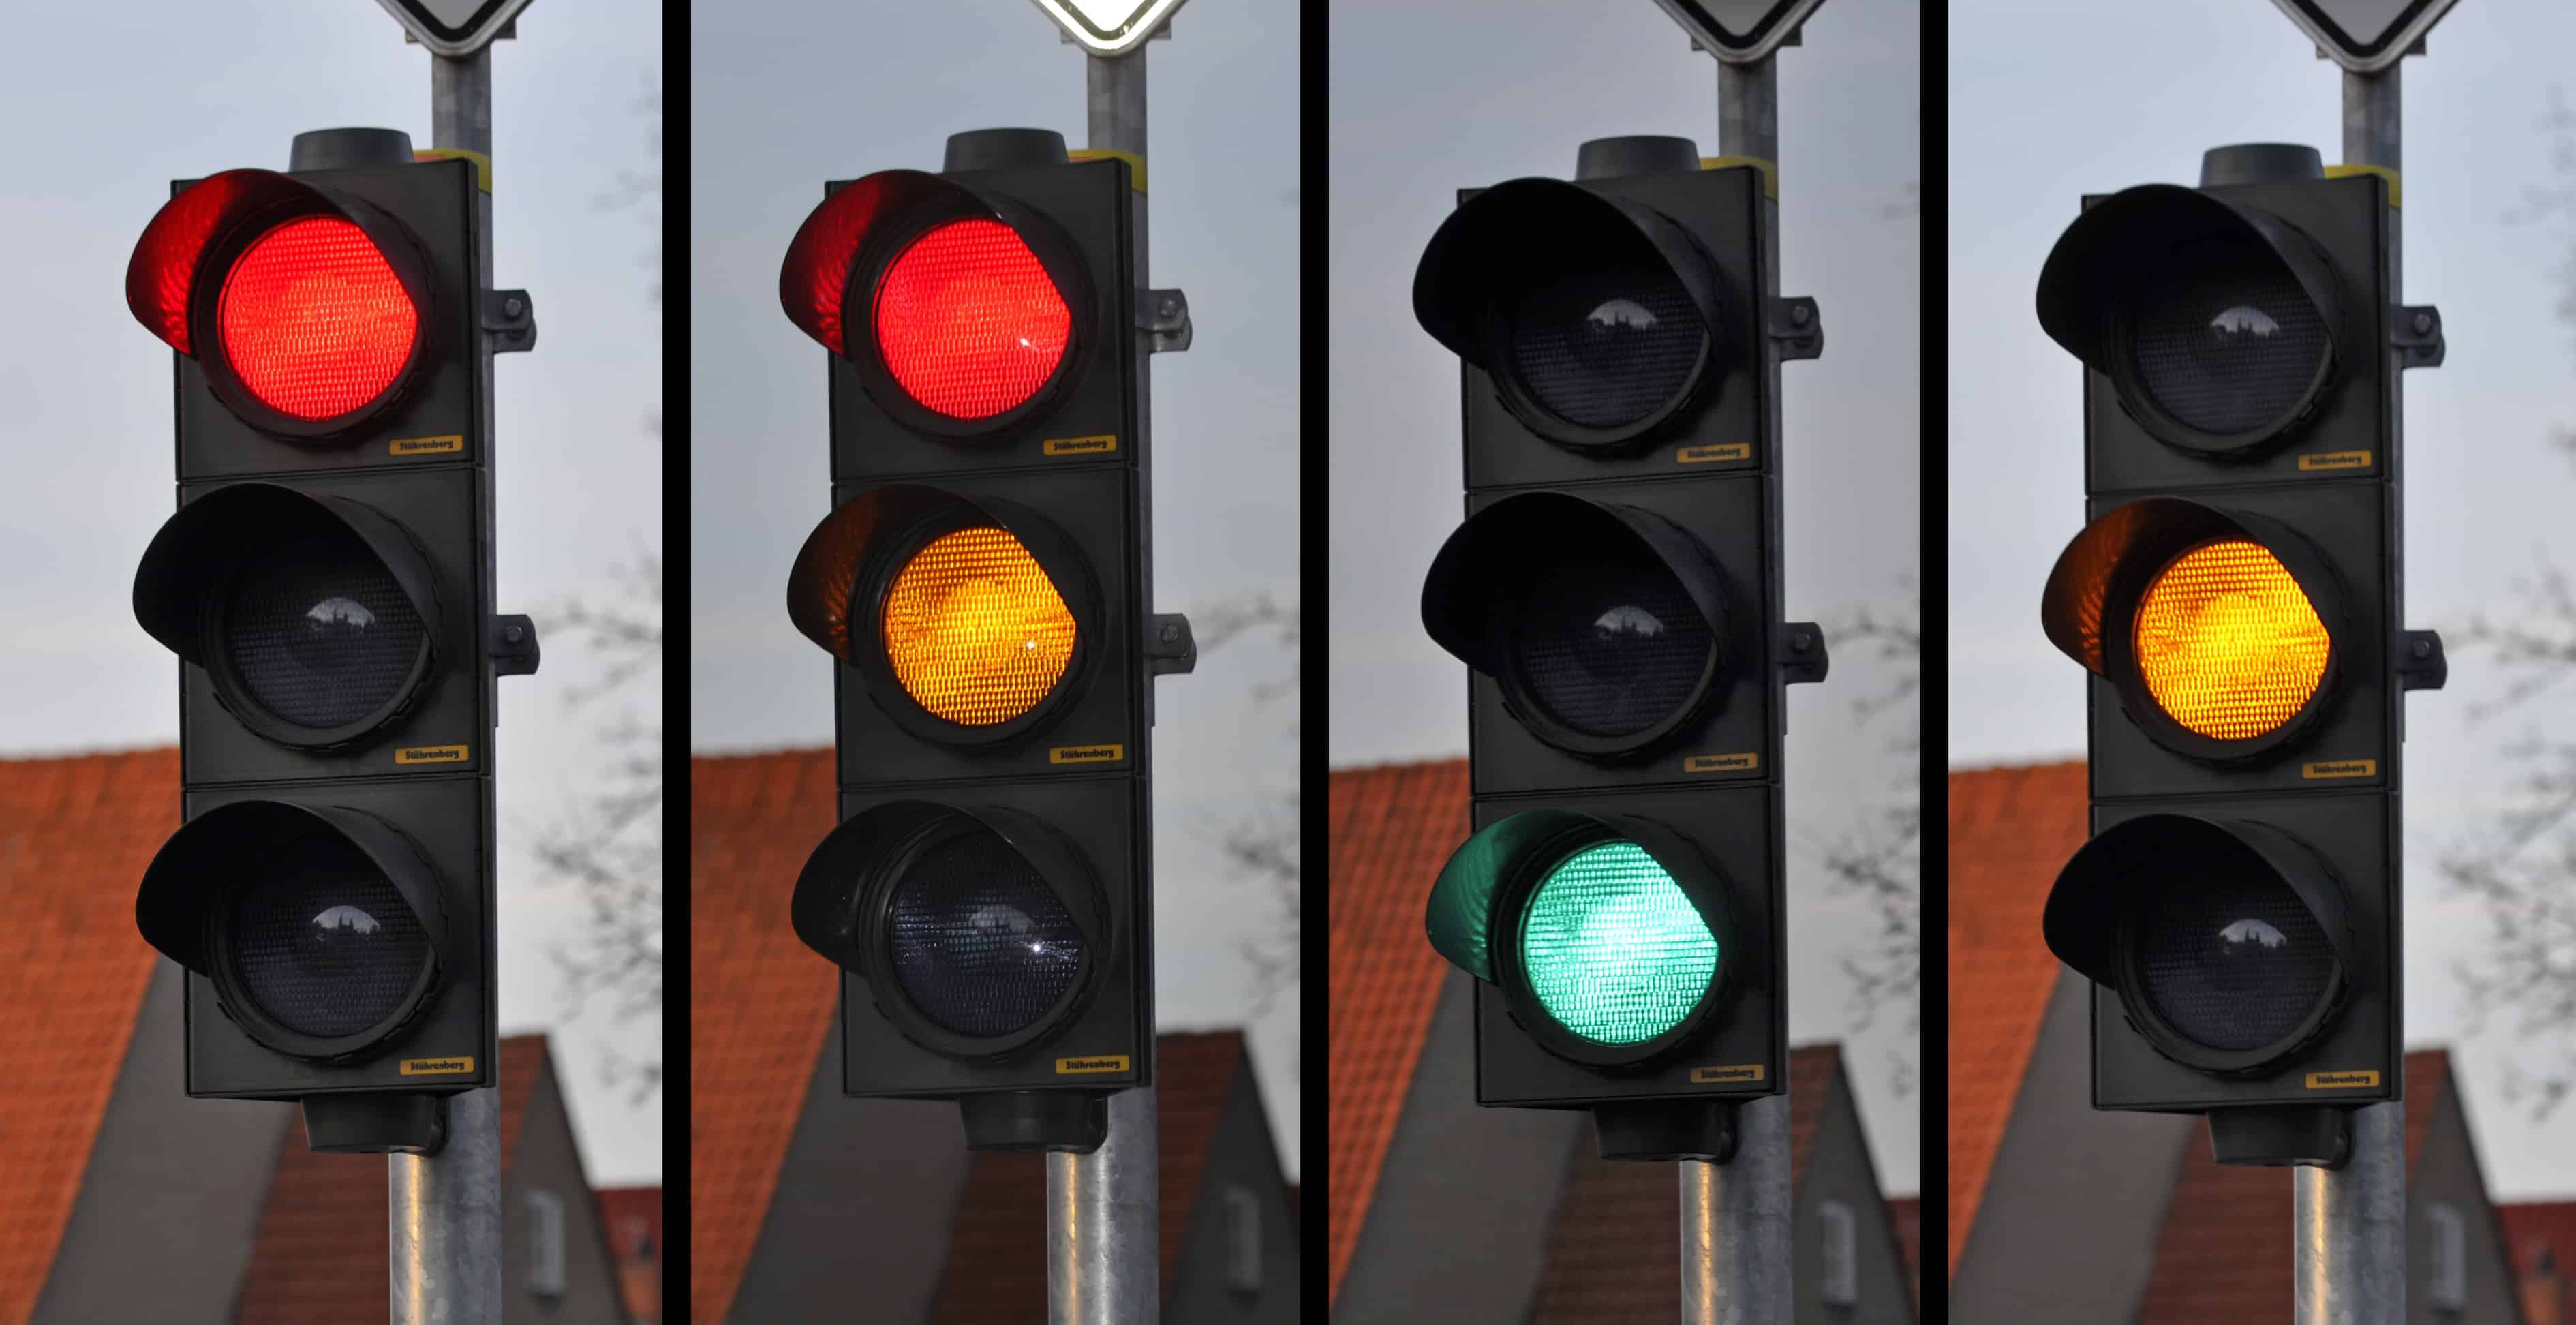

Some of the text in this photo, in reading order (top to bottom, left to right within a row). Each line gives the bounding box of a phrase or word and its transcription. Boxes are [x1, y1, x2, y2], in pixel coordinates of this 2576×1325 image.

[399, 440, 453, 451] Stührenberg
[1053, 439, 1107, 451] Stührenberg
[1687, 446, 1741, 459] Stührenberg
[2308, 455, 2362, 466] Stührenberg
[405, 748, 459, 760] Stührenberg
[1060, 748, 1114, 759] Stührenberg
[1694, 757, 1749, 769] Stührenberg
[2313, 763, 2367, 774] Stührenberg
[410, 1061, 465, 1071] Stührenberg
[1066, 1059, 1120, 1070] Stührenberg
[1700, 1068, 1755, 1080] Stührenberg
[2316, 1073, 2370, 1085] Stührenberg
